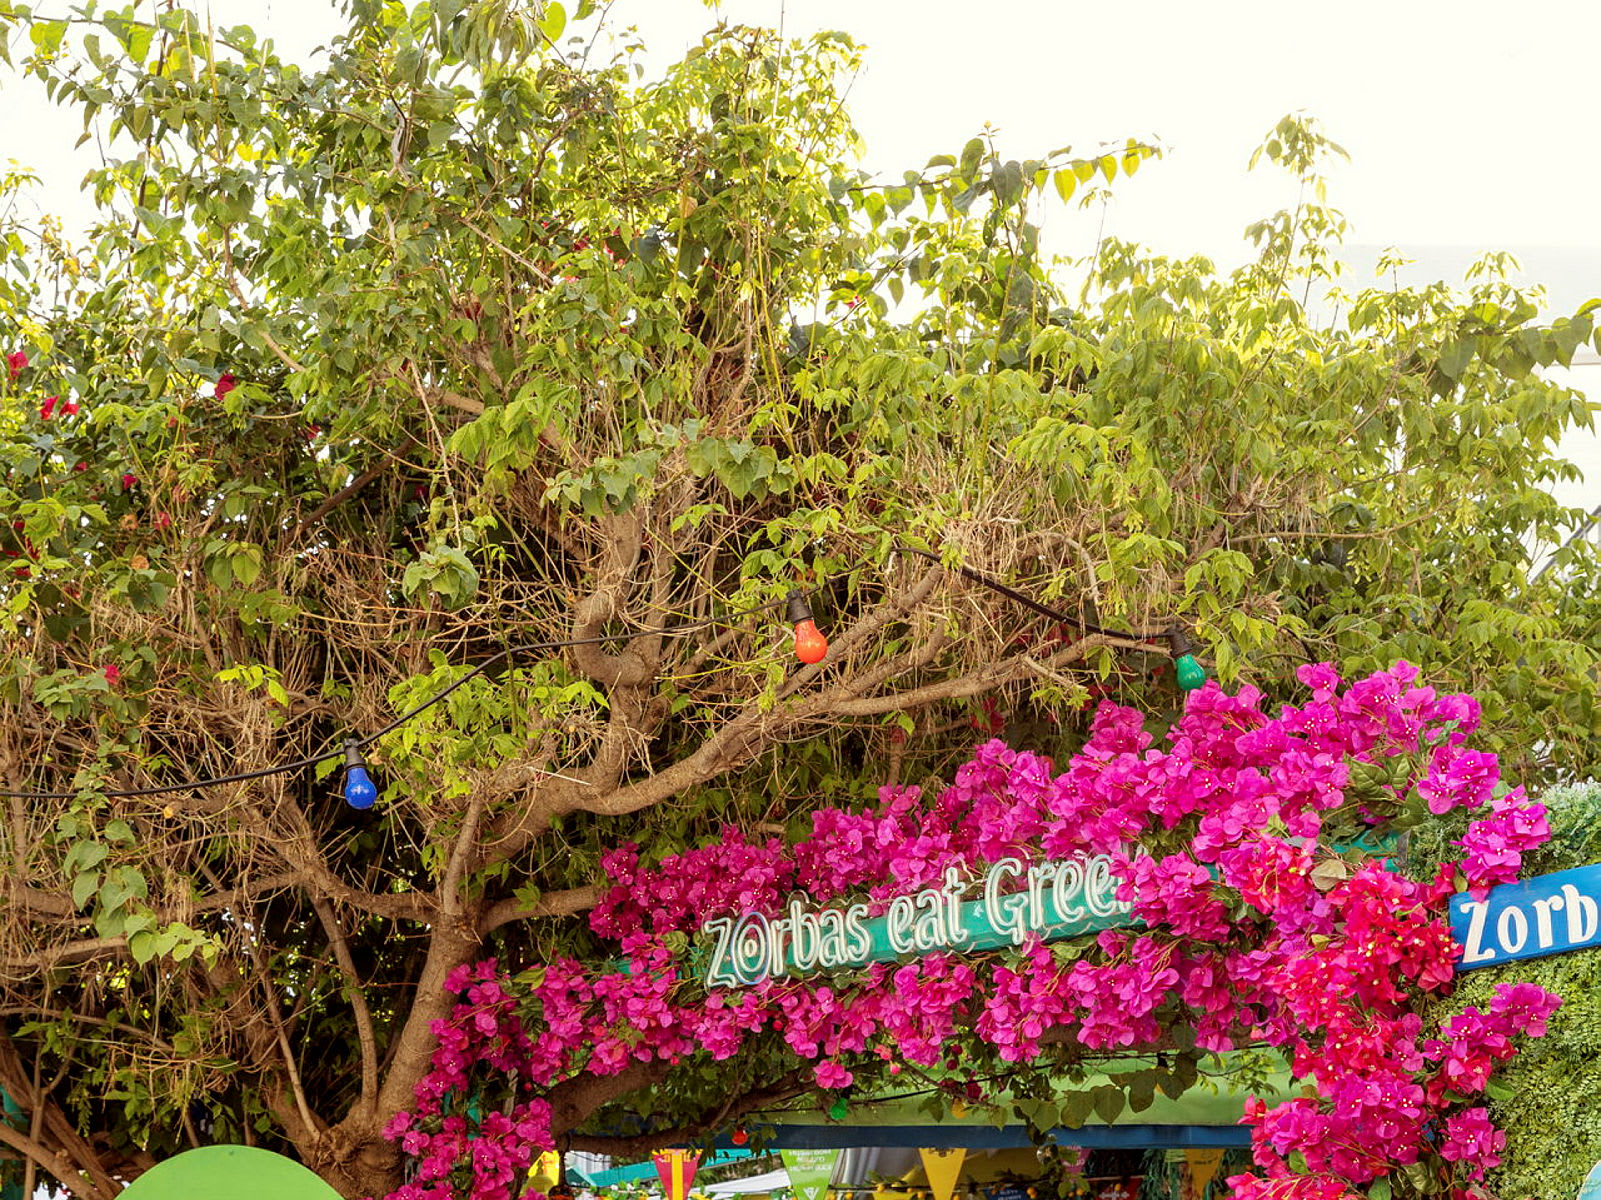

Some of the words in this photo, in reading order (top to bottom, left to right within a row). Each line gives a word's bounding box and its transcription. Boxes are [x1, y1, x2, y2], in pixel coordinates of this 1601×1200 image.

[705, 898, 871, 989] Zorbas
[886, 867, 968, 953] eat
[1460, 884, 1599, 964] Zorb
